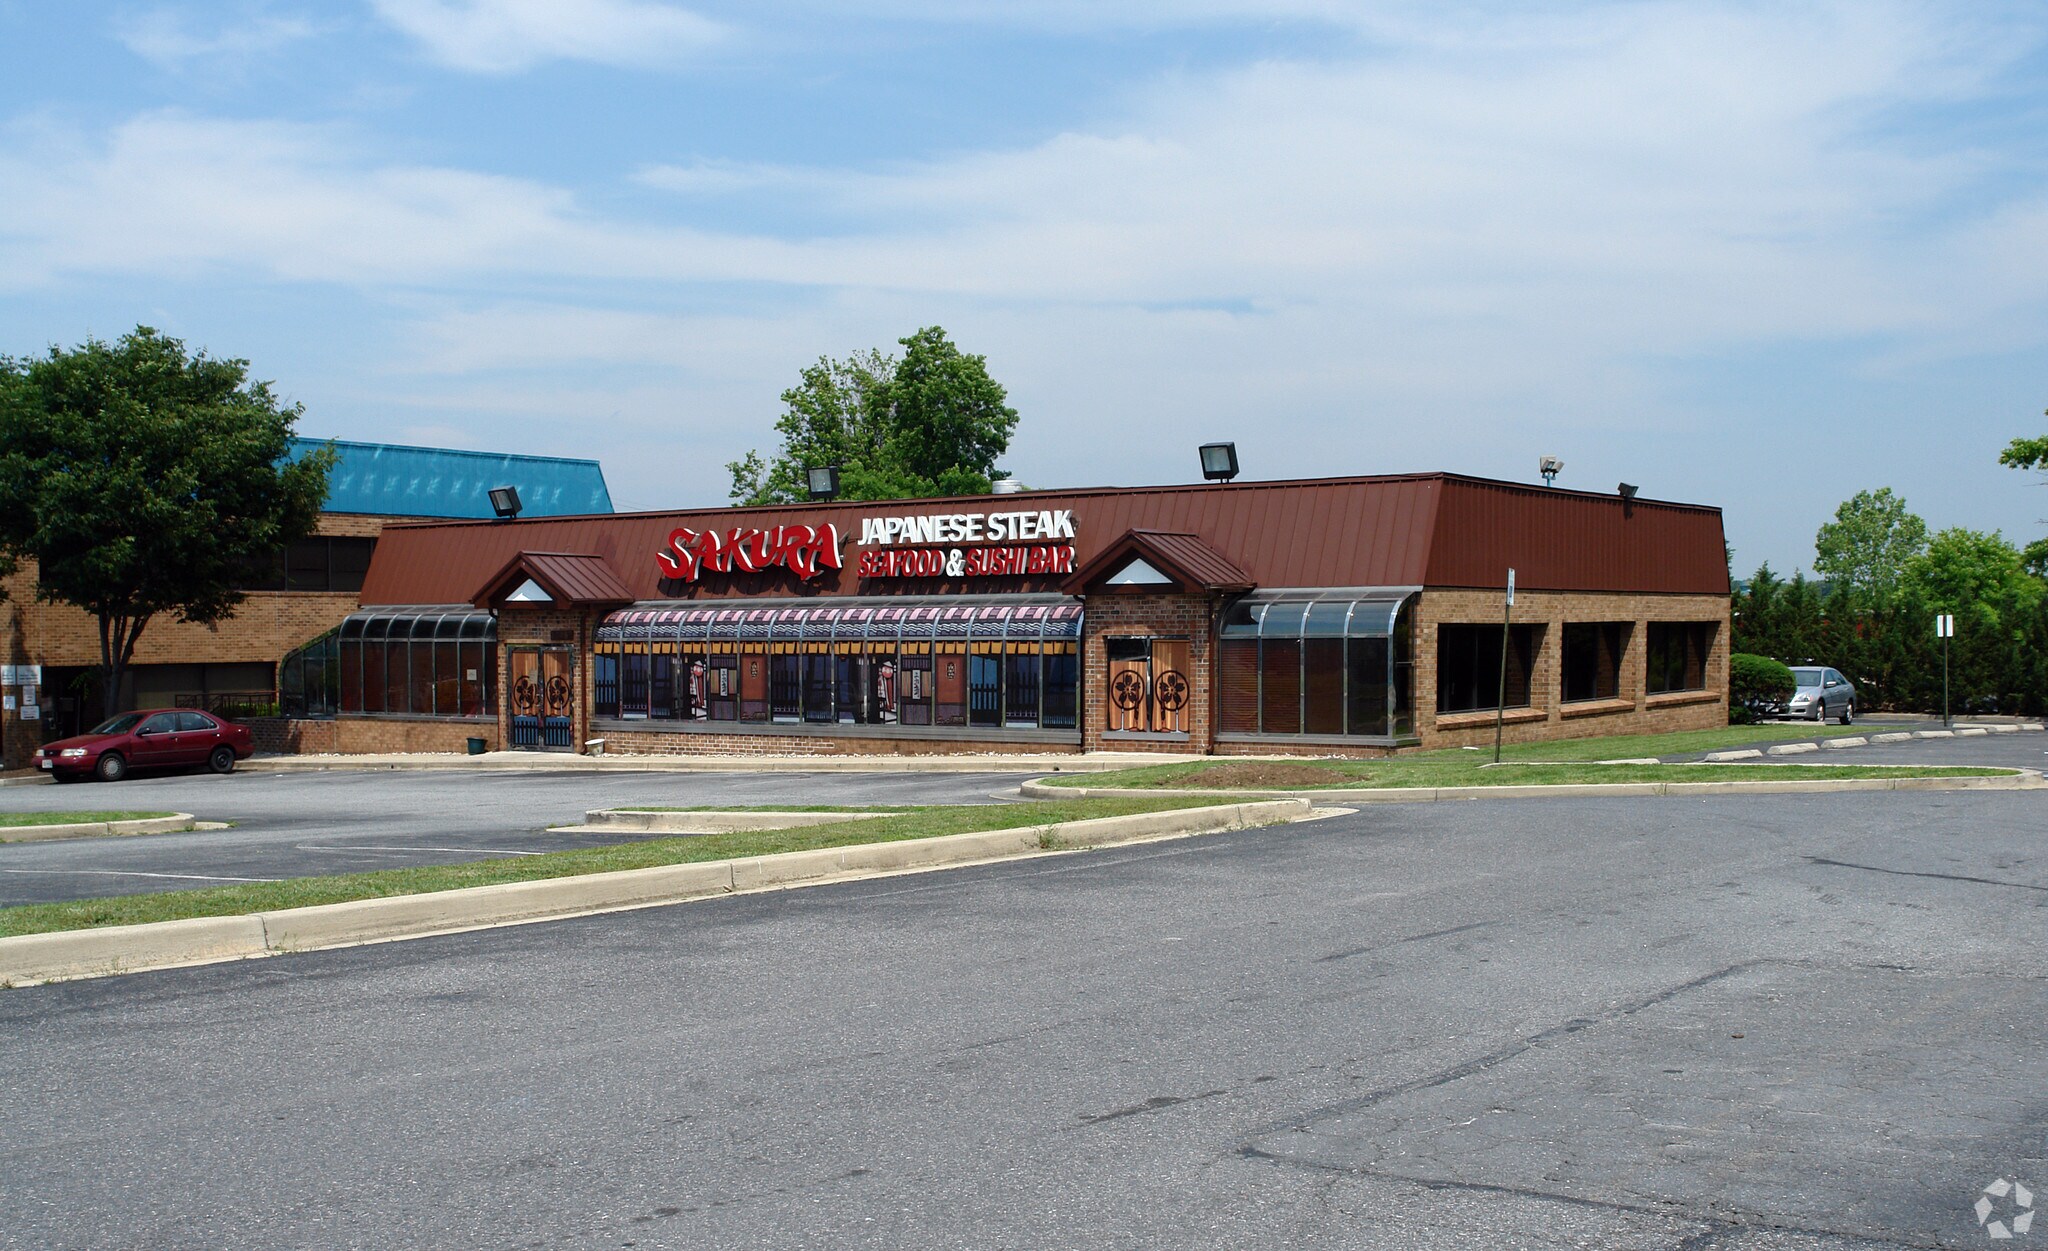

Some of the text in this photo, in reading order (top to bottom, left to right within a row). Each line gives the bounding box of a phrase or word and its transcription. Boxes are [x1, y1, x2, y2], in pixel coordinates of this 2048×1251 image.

[858, 510, 1075, 546] JAPANESE STEAK
[656, 523, 842, 583] SAKURA
[857, 545, 1074, 578] SEAFOOD & SUSHI BAR
